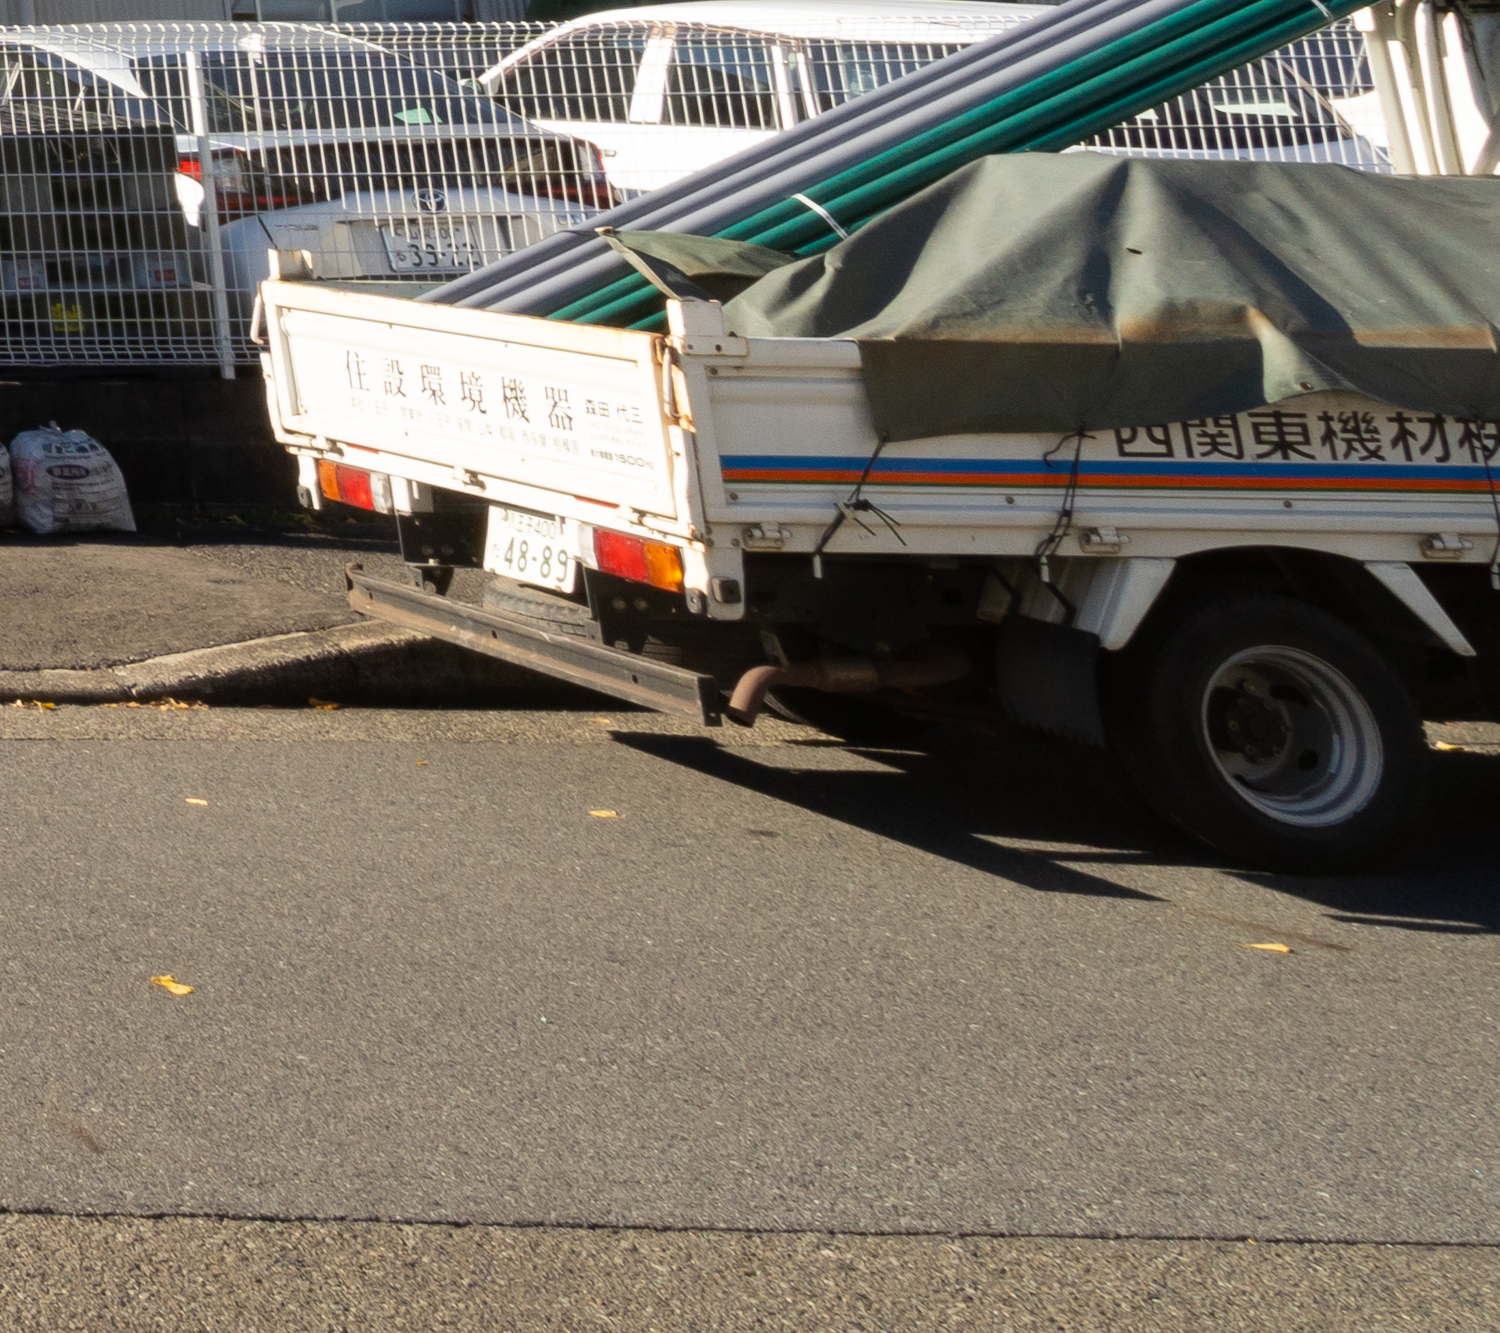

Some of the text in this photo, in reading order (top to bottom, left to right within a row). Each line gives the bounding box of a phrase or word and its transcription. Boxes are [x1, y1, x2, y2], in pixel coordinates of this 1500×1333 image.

[345, 350, 574, 431] 住設環境機器
[503, 536, 568, 583] 48-89
